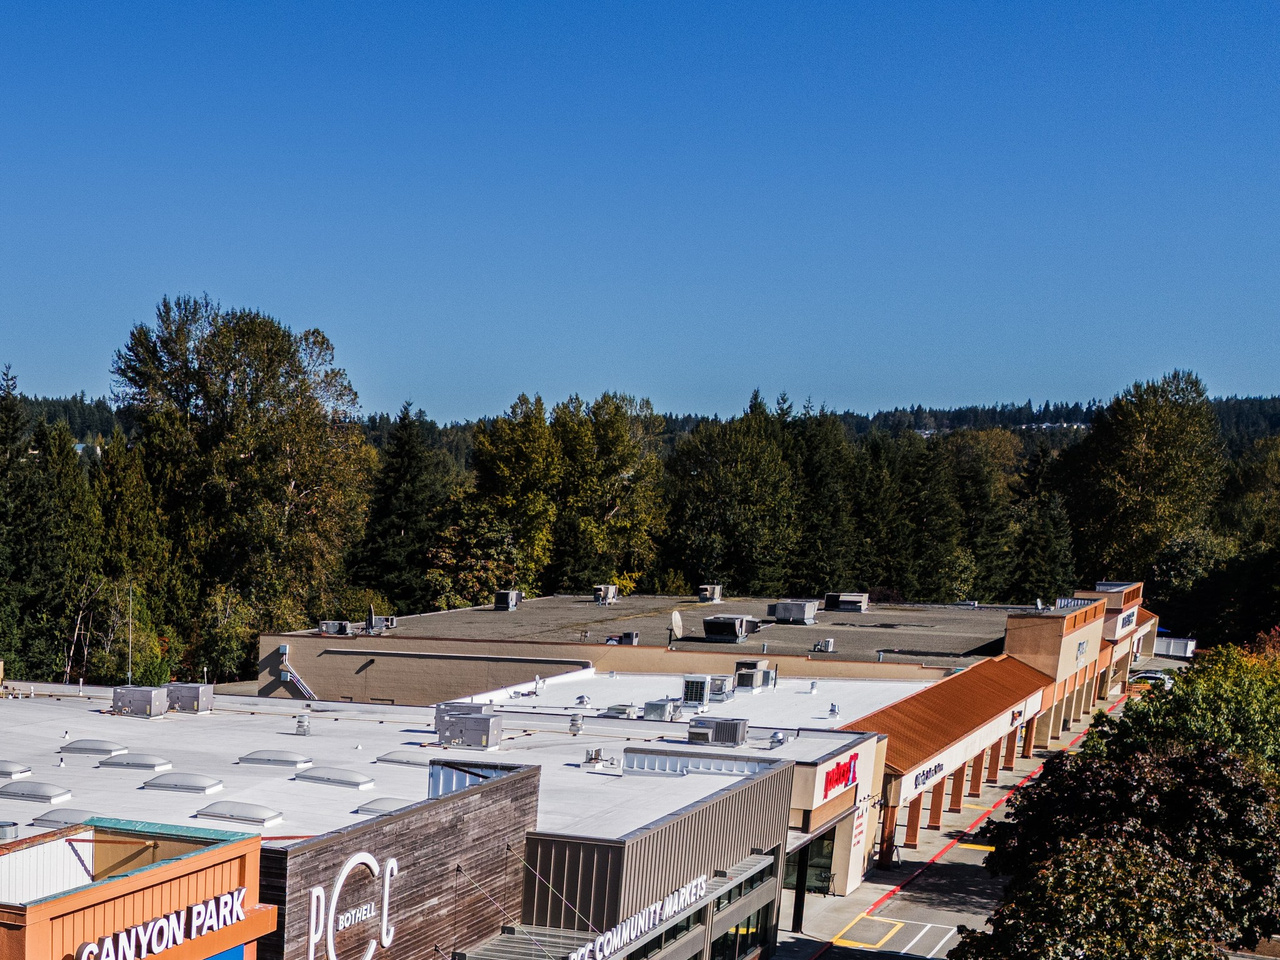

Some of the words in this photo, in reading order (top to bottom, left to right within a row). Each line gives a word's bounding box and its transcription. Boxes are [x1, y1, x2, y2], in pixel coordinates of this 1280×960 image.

[187, 887, 247, 940] PARK
[336, 902, 376, 931] BOTHELL
[662, 875, 707, 921] MARKETS
